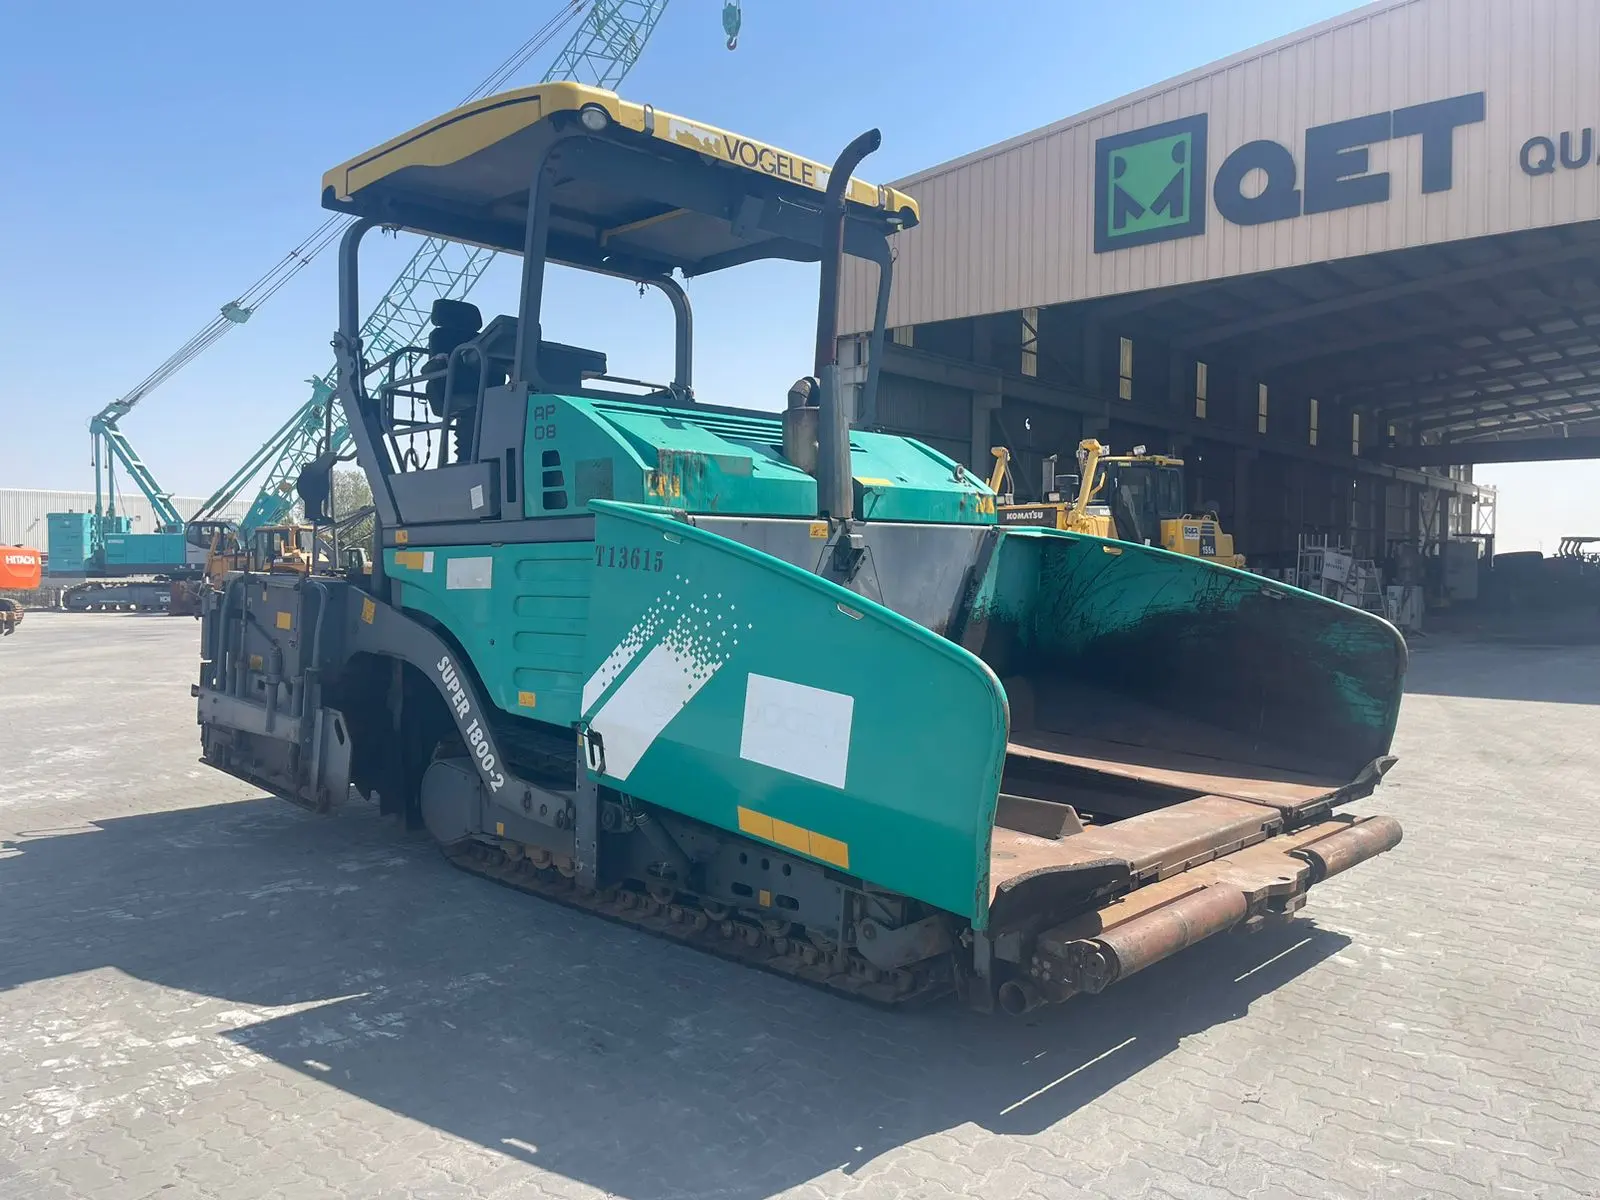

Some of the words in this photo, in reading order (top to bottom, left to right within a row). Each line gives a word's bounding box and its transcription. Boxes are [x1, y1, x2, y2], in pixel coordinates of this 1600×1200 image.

[1213, 91, 1484, 226] QET
[1519, 127, 1600, 176] QU
[534, 404, 556, 422] AP
[1006, 510, 1044, 520] KOMATSU
[595, 545, 665, 572] T13615
[436, 655, 471, 720] SUPER
[466, 718, 505, 793] 1800-2
